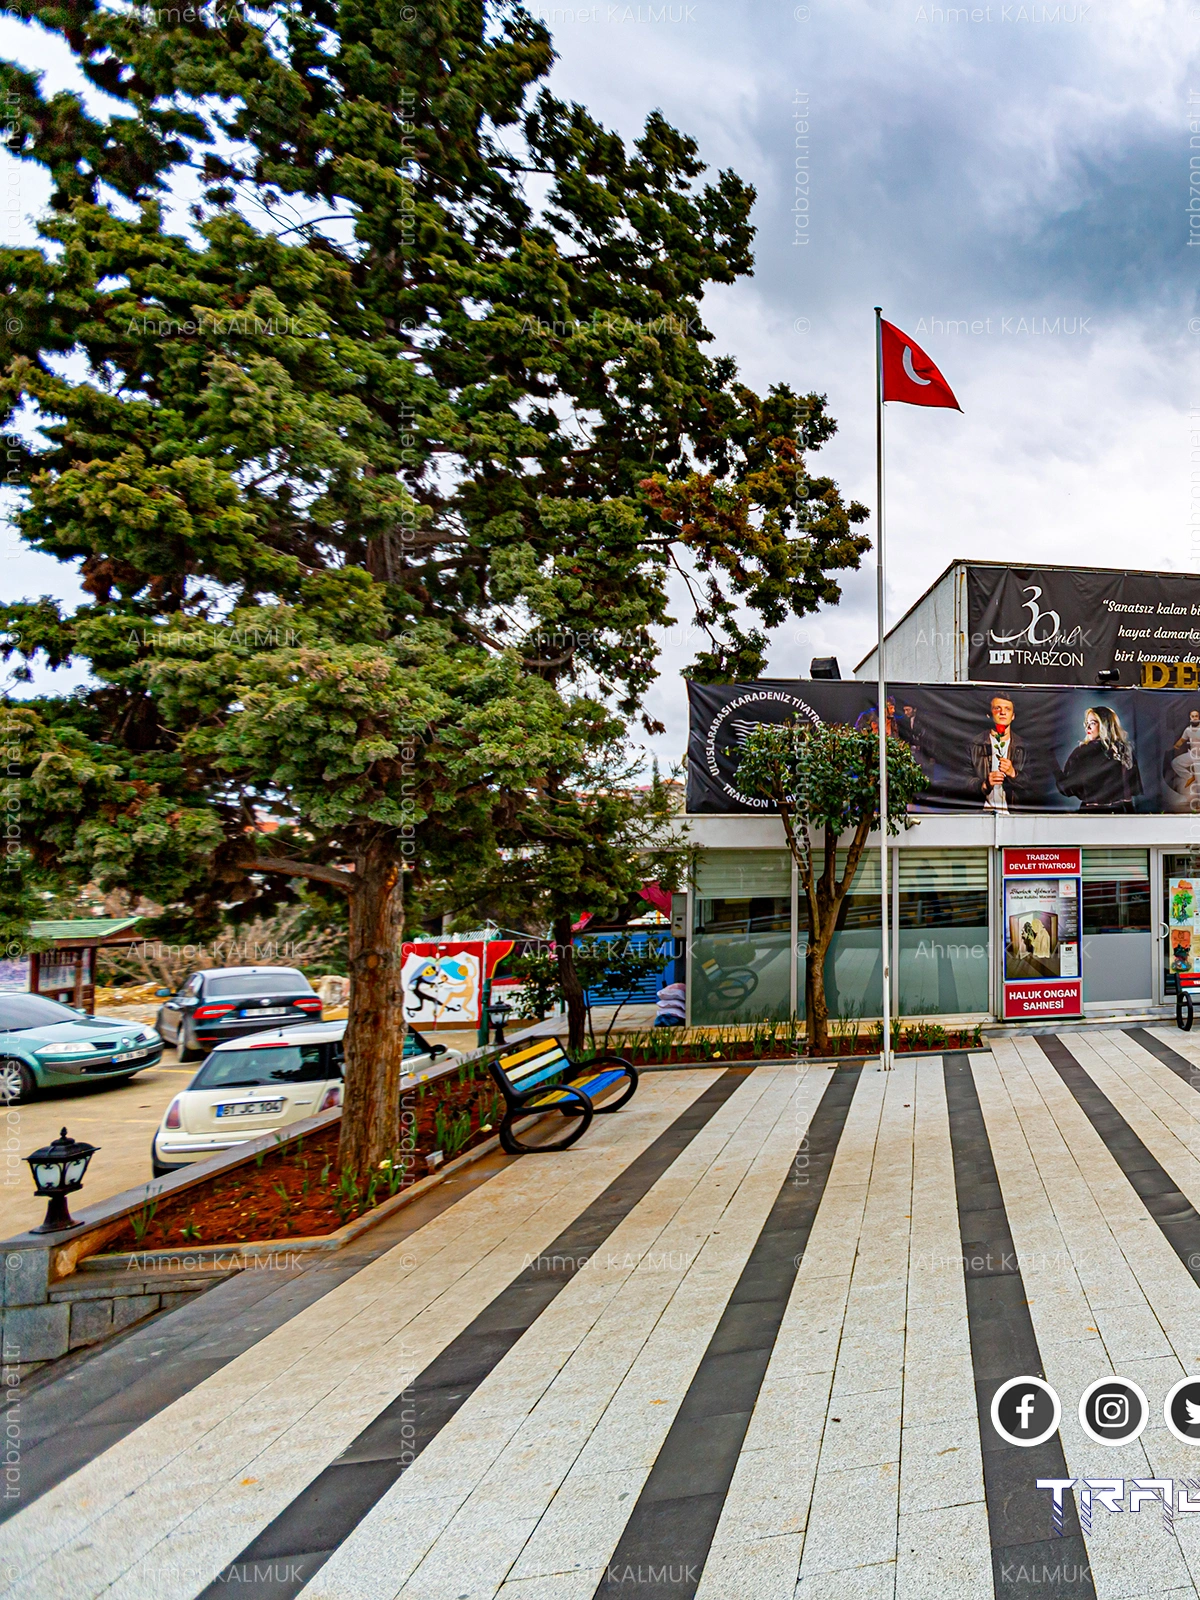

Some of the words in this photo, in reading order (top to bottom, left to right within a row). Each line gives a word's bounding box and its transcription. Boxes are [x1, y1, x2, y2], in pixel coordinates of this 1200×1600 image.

[1102, 599, 1154, 614] “Sanatsız
[1156, 603, 1187, 616] kalan
[1117, 625, 1151, 640] hayat
[1015, 650, 1084, 667] TRABZON
[1114, 649, 1135, 662] biri
[705, 704, 733, 777] ULUSLARARASI
[1038, 862, 1076, 870] TİYATROSU
[1009, 990, 1042, 1000] HALUK
[1043, 989, 1078, 998] ONGAN
[1022, 999, 1064, 1011] SAHNESİ
[240, 1103, 254, 1114] JC
[260, 1102, 279, 1112] 104
